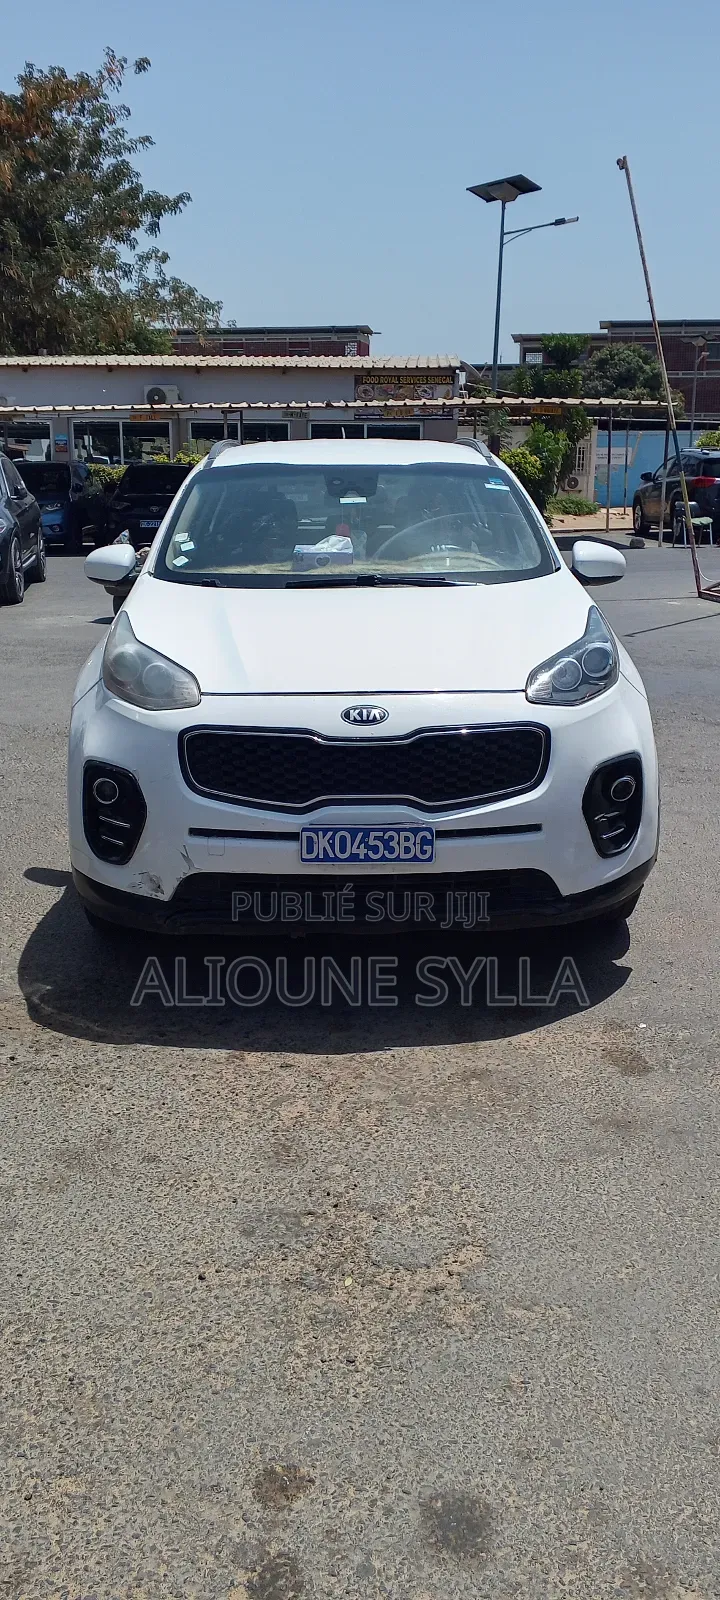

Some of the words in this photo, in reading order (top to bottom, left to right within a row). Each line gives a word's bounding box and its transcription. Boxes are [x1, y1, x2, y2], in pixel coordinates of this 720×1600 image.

[362, 376, 379, 384] FOOD
[380, 376, 399, 384] ROYAL
[400, 376, 427, 384] SERVICES
[427, 376, 453, 384] SENEGAL
[349, 709, 383, 721] KIA
[301, 830, 433, 860] DK0453BG
